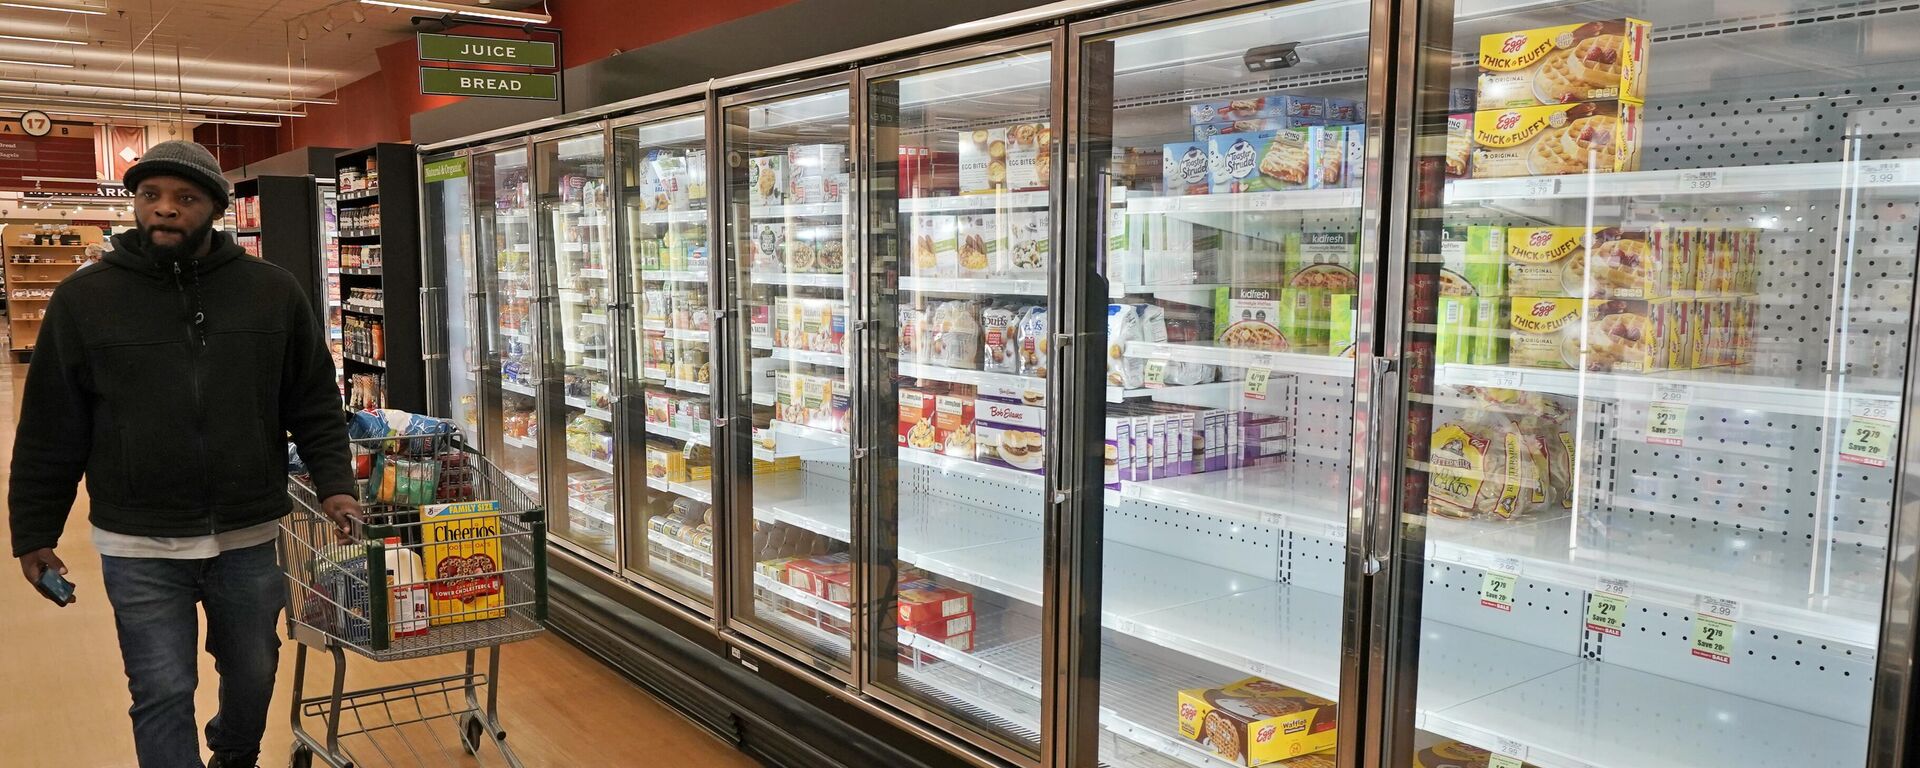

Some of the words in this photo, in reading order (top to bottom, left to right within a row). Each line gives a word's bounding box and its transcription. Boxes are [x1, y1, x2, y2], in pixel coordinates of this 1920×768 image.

[1502, 36, 1528, 53] Eggo
[461, 44, 516, 58] JUICE
[1483, 54, 1511, 68] THICK
[1518, 39, 1552, 66] FLUFFY
[460, 77, 522, 91] BREAD
[27, 118, 46, 129] 17
[1496, 114, 1521, 130] Eggo
[3, 124, 11, 132] A
[61, 127, 69, 135] B
[1477, 130, 1505, 144] THICK
[1512, 117, 1546, 143] FLUFFY
[1284, 130, 1300, 140] ICING
[1228, 151, 1251, 161] Toaster
[1020, 158, 1035, 166] BITES
[1183, 158, 1205, 168] Toaster
[1227, 153, 1255, 174] Strudel
[1182, 160, 1208, 179] Strudel
[1870, 174, 1893, 183] 3.99
[1691, 180, 1711, 189] 3.99
[1312, 235, 1344, 243] kidfresh
[1529, 232, 1552, 247] Eggo
[1511, 245, 1539, 260] THICK
[1545, 237, 1577, 259] FLUFFY
[1240, 289, 1270, 299] kidfresh
[1531, 301, 1555, 317] Eggo
[1514, 315, 1540, 331] THICK
[1546, 308, 1579, 330] FLUFFY
[1662, 392, 1681, 401] 2.99
[990, 406, 1003, 417] Bob
[1003, 408, 1023, 420] Evans
[1863, 408, 1887, 417] 2.99
[1848, 443, 1867, 452] Save
[449, 504, 476, 514] FAMILY
[477, 502, 494, 511] SIZE
[435, 523, 496, 543] Cheerios
[1605, 584, 1623, 594] 2.99
[1486, 591, 1498, 599] Save
[1711, 605, 1730, 616] 2.99
[1592, 614, 1606, 622] Save
[1697, 639, 1713, 648] Save
[1181, 703, 1197, 720] Eggo
[1282, 719, 1307, 728] Waffles
[1256, 727, 1277, 743] Eggo
